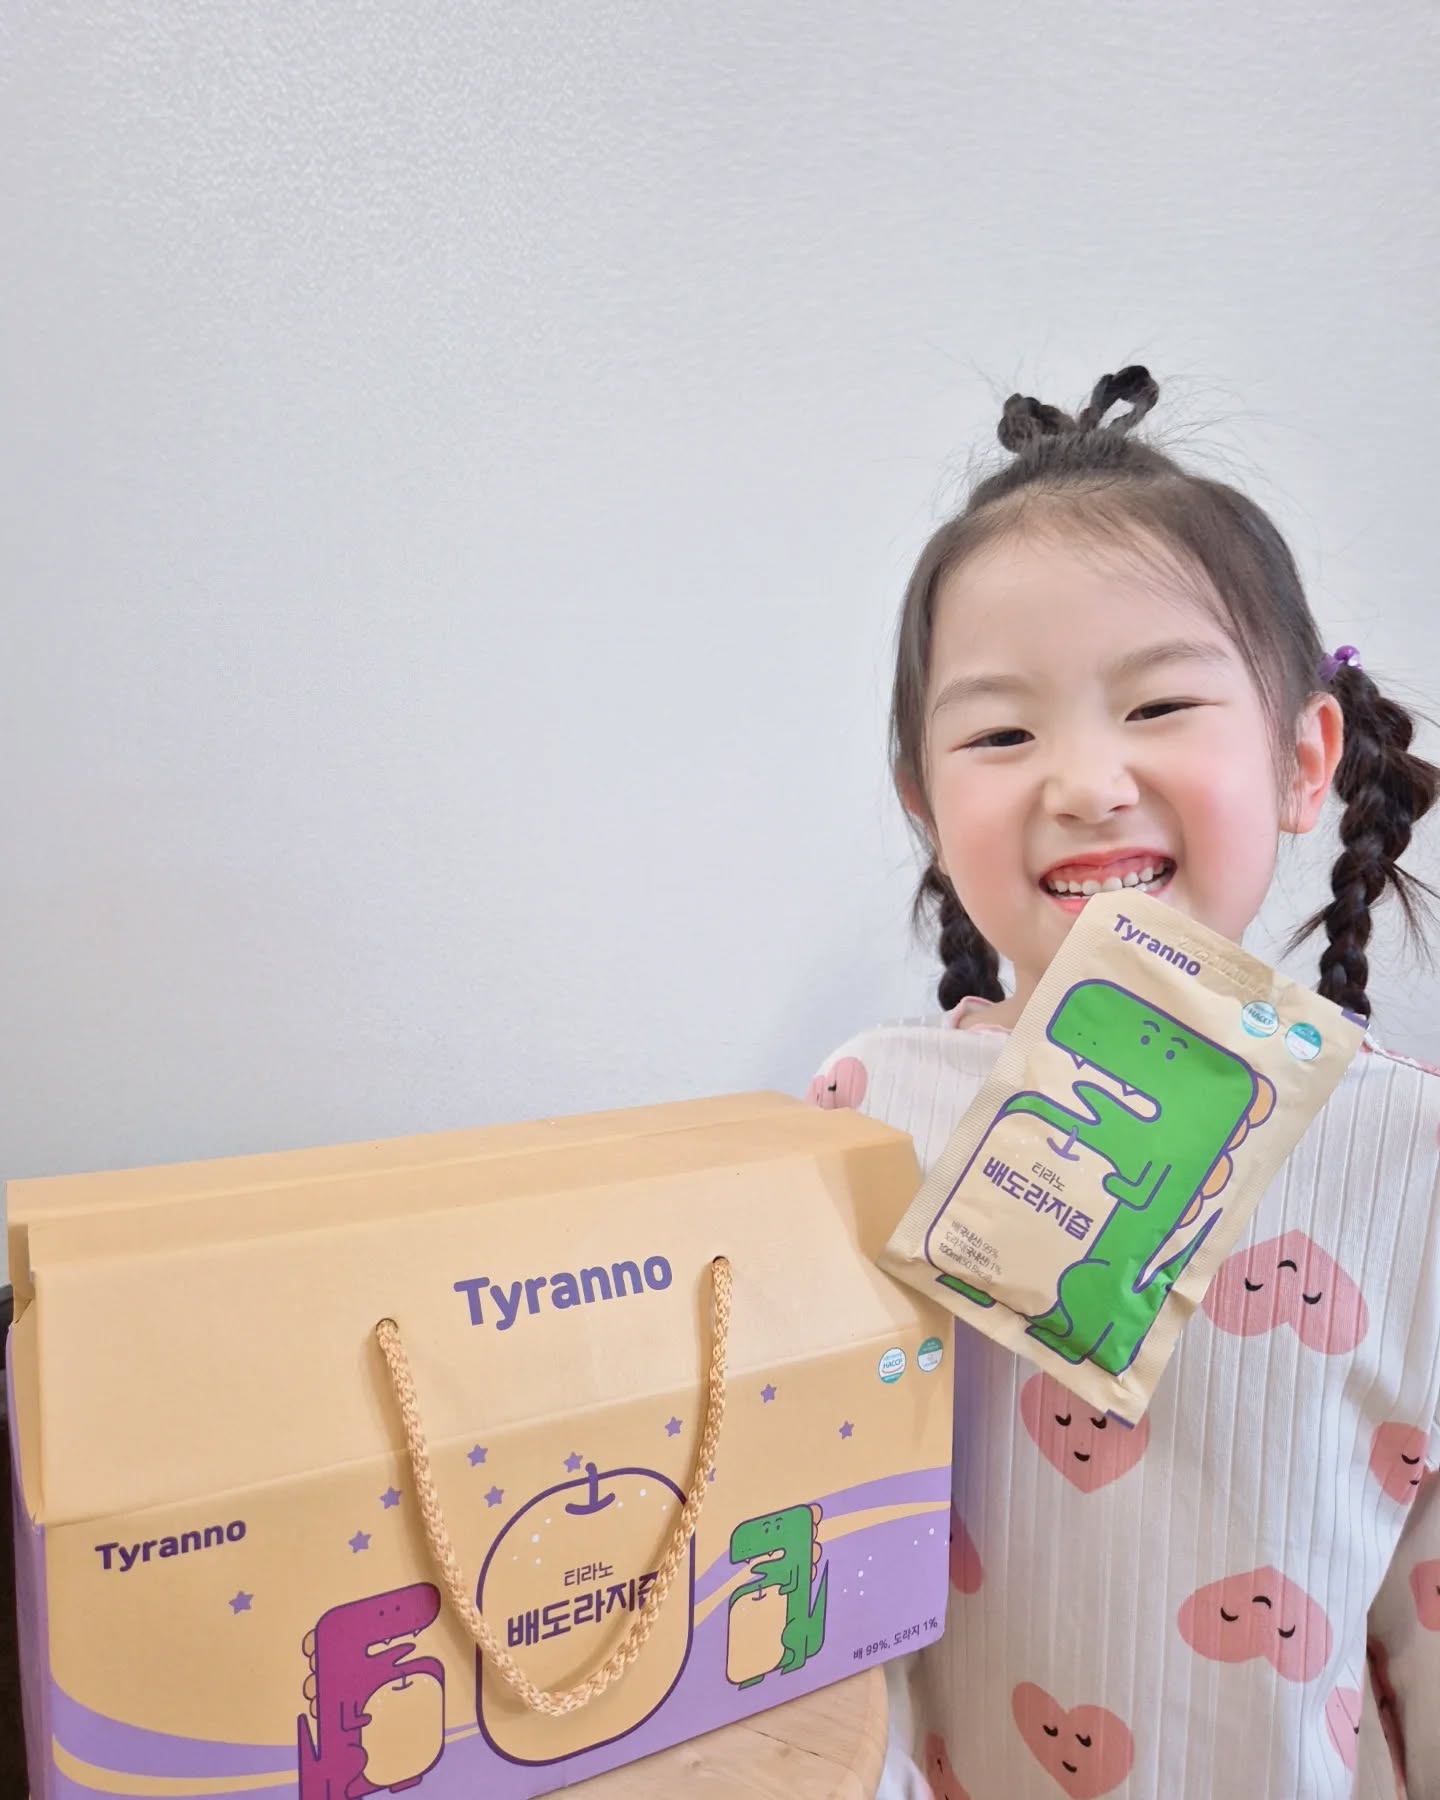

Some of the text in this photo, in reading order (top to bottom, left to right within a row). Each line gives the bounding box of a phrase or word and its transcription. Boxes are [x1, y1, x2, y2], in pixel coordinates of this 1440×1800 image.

[1113, 914, 1201, 976] Tyranno
[983, 1156, 1094, 1241] 배도라지즙
[1031, 1161, 1065, 1192] 티라노
[453, 1255, 673, 1331] Tyranno
[882, 1358, 903, 1369] HACCP
[94, 1520, 246, 1572] Tyranno
[564, 1561, 614, 1587] 티라노
[852, 1647, 864, 1660] 배
[893, 1623, 920, 1646] 도라지
[923, 1616, 938, 1631] 1%
